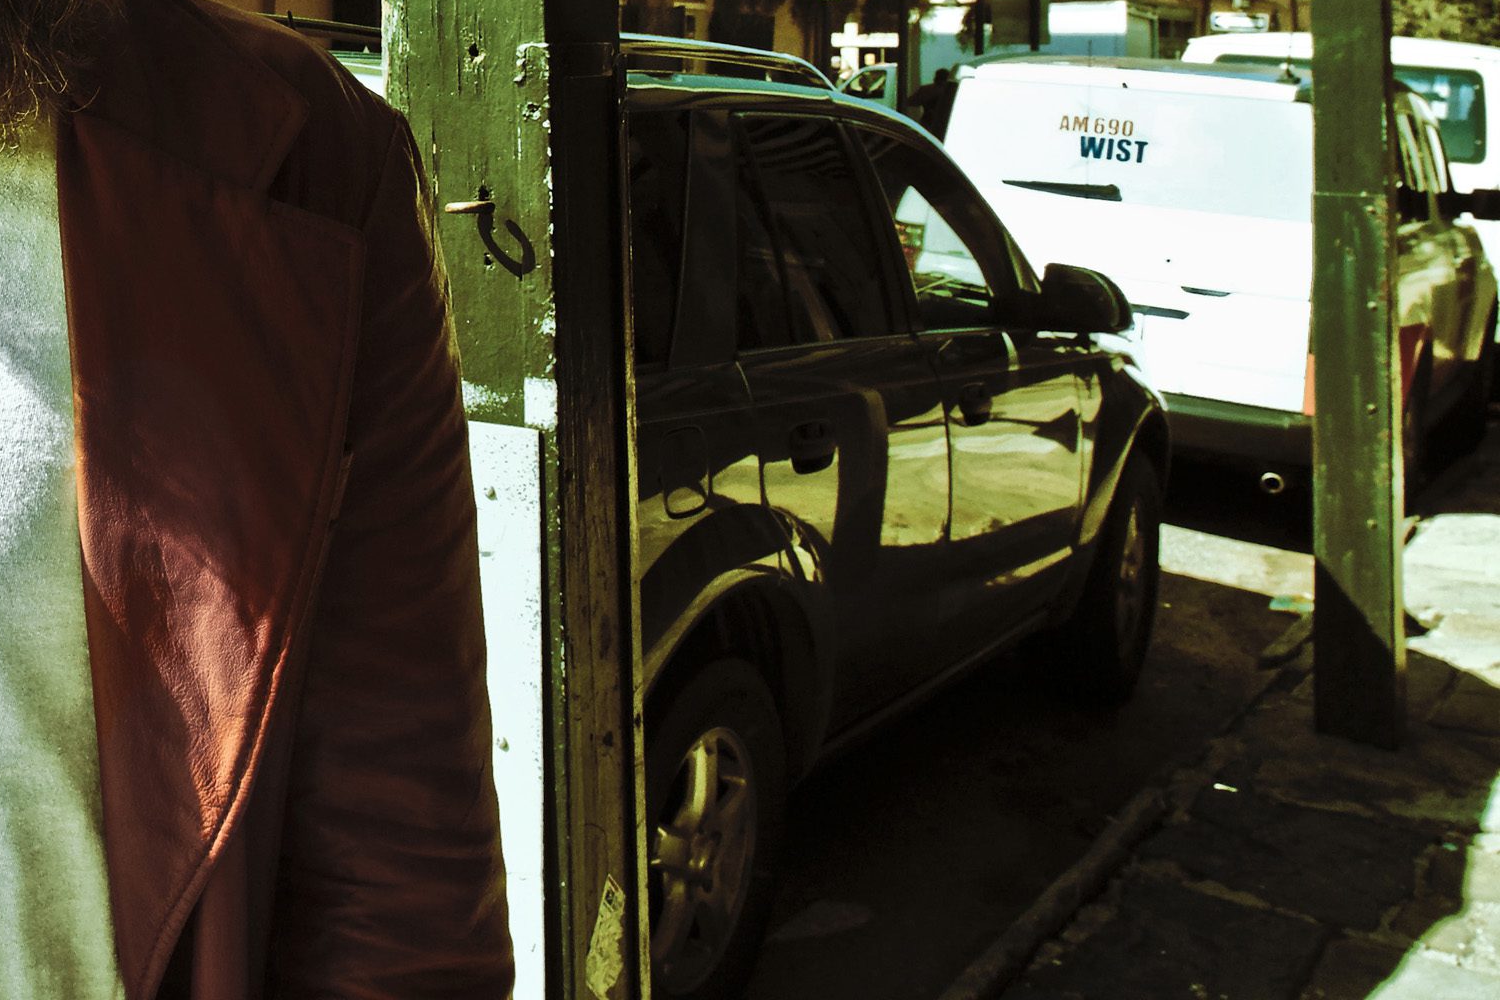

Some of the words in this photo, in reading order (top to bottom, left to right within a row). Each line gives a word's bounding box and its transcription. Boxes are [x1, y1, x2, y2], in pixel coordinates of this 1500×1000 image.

[1059, 115, 1089, 133] AM
[1094, 117, 1134, 137] 690
[1080, 135, 1149, 163] WIST
